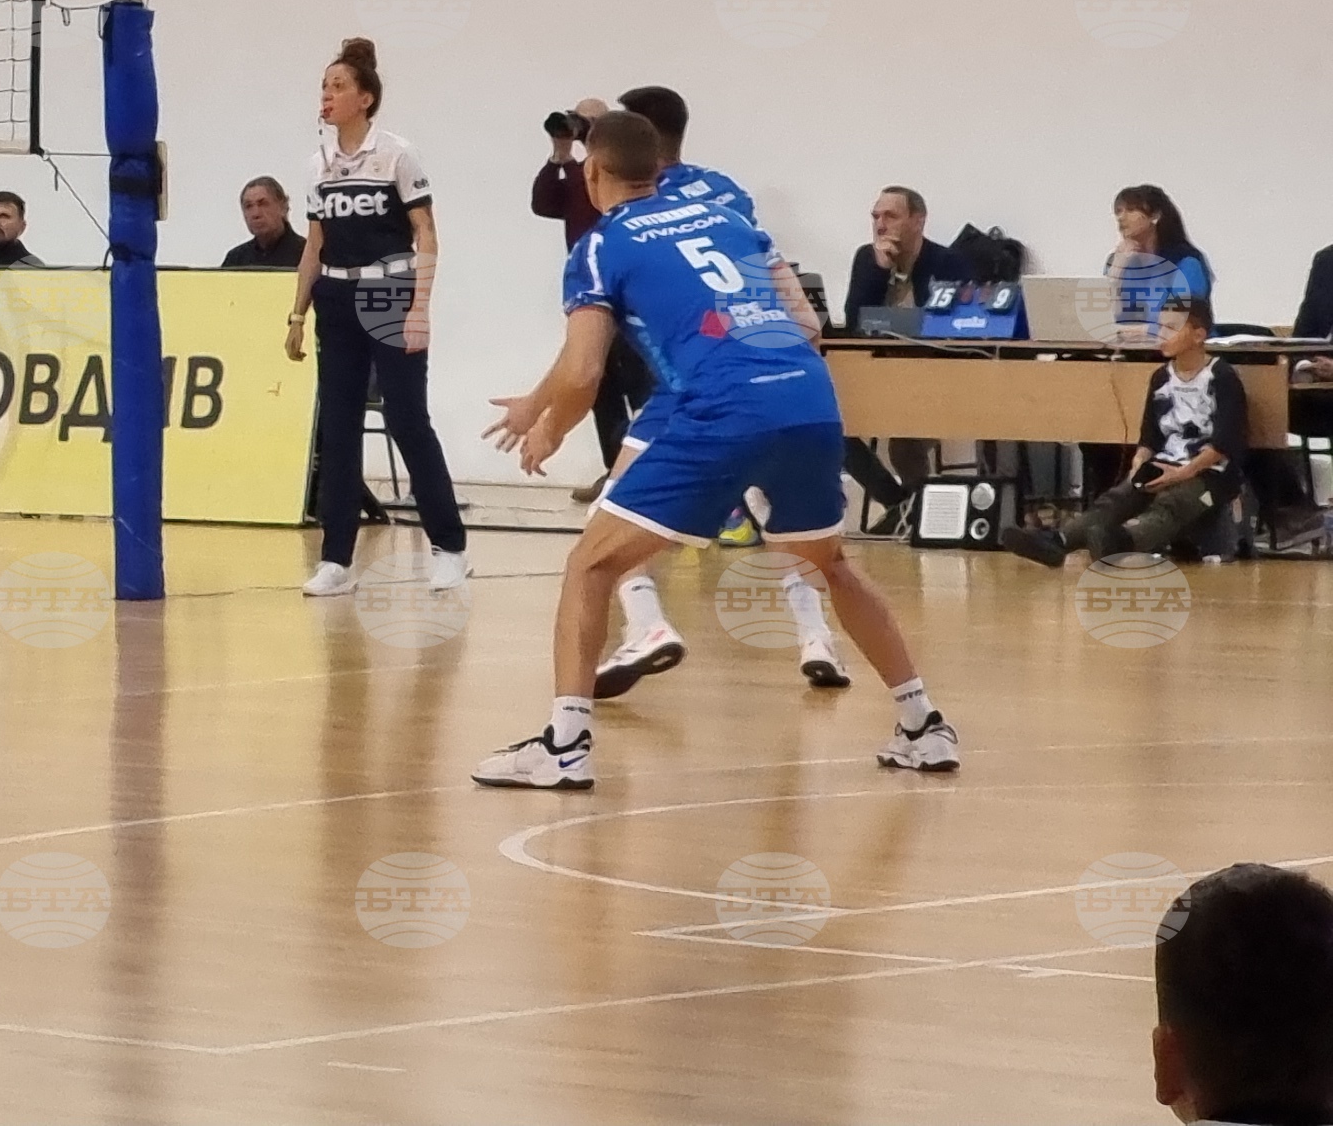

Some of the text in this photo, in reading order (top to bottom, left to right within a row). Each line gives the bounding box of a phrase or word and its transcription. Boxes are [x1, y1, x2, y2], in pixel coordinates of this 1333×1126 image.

[632, 214, 729, 243] VIVACOM
[675, 236, 745, 294] 5
[929, 287, 956, 308] 15
[993, 288, 1010, 308] 9
